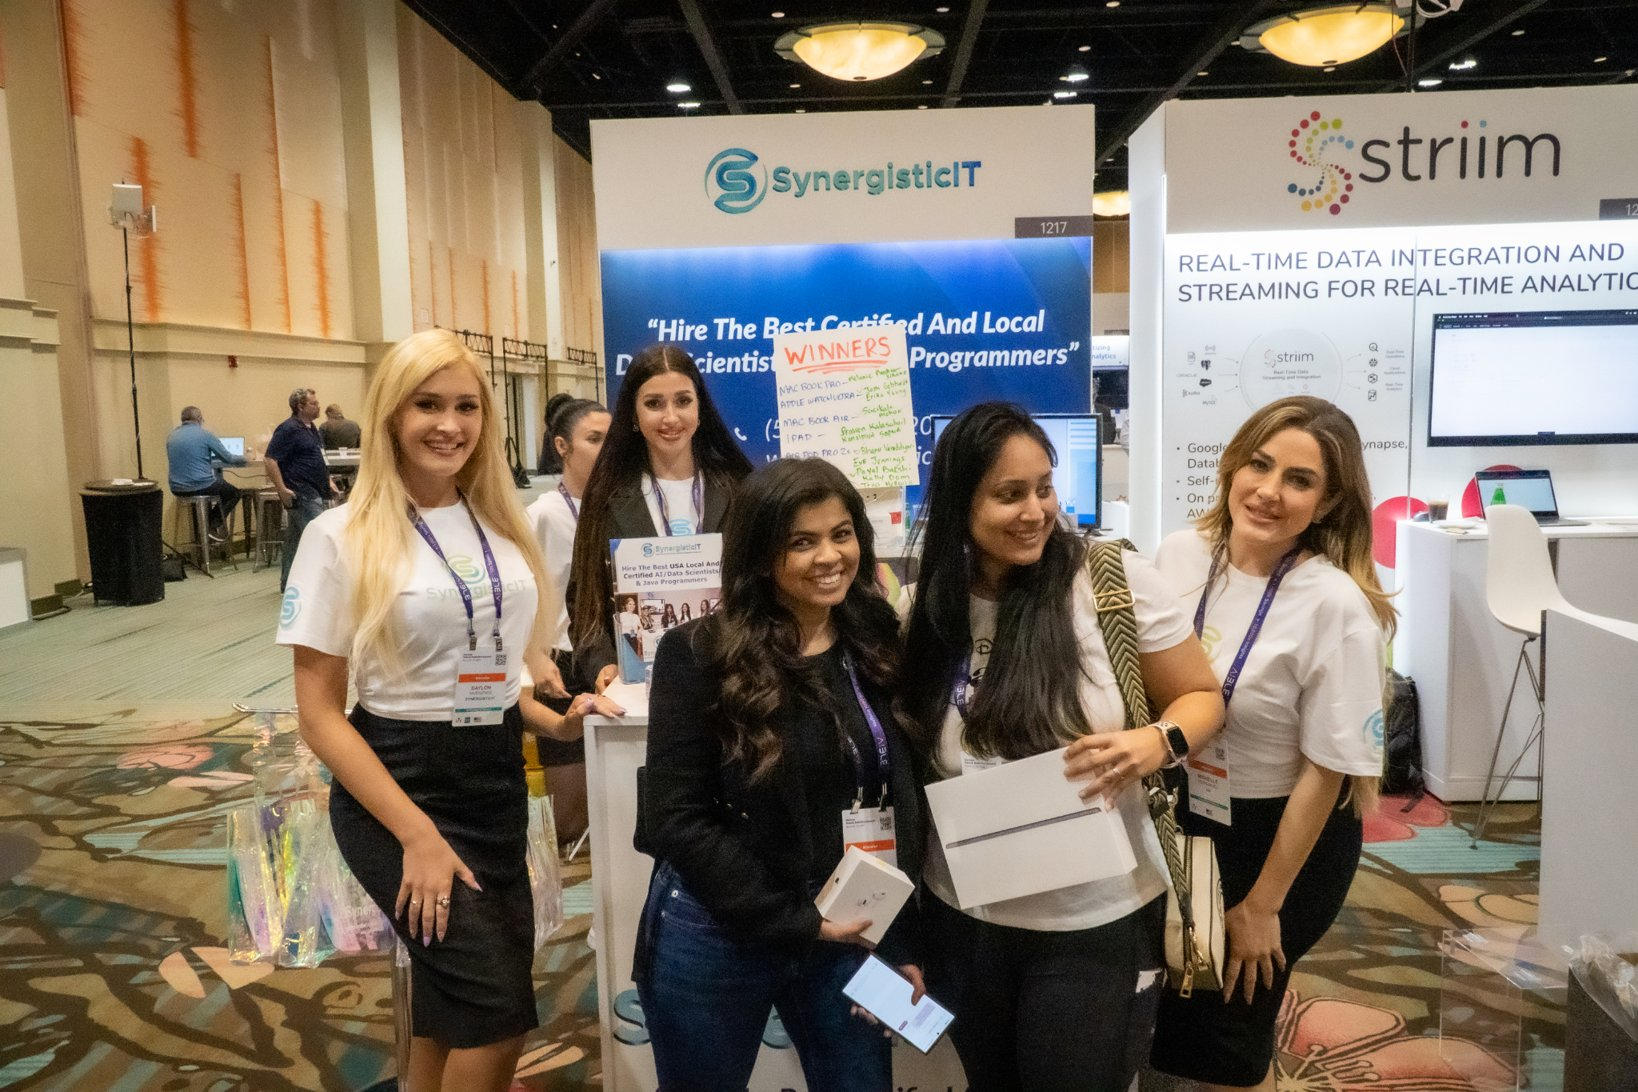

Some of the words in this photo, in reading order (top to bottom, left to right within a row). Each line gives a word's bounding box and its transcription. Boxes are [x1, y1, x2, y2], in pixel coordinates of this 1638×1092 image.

[1359, 120, 1561, 183] striim
[772, 160, 982, 198] SynergisticIT
[1040, 220, 1068, 235] 1217
[1179, 251, 1307, 273] REAL-TIME
[1318, 249, 1382, 269] DATA
[1391, 244, 1560, 268] INTEGRATION
[1569, 242, 1625, 263] AND
[1178, 280, 1319, 303] STREAMING
[1327, 279, 1376, 299] FOR
[1384, 275, 1513, 298] REAL-TIME
[1521, 270, 1638, 294] ANALYTIC
[713, 318, 757, 340] The
[763, 316, 815, 339] Best
[927, 311, 978, 335] And
[983, 309, 1045, 334] Local
[784, 336, 892, 366] WINNERS
[1277, 351, 1314, 363] striim
[801, 382, 823, 391] BOOK
[780, 398, 805, 408] APPLE
[784, 417, 804, 427] MAC
[808, 416, 830, 425] BOOK
[1362, 440, 1408, 451] ynapse,
[1187, 493, 1204, 504] On
[686, 560, 704, 568] Local
[661, 577, 708, 587] Programmers
